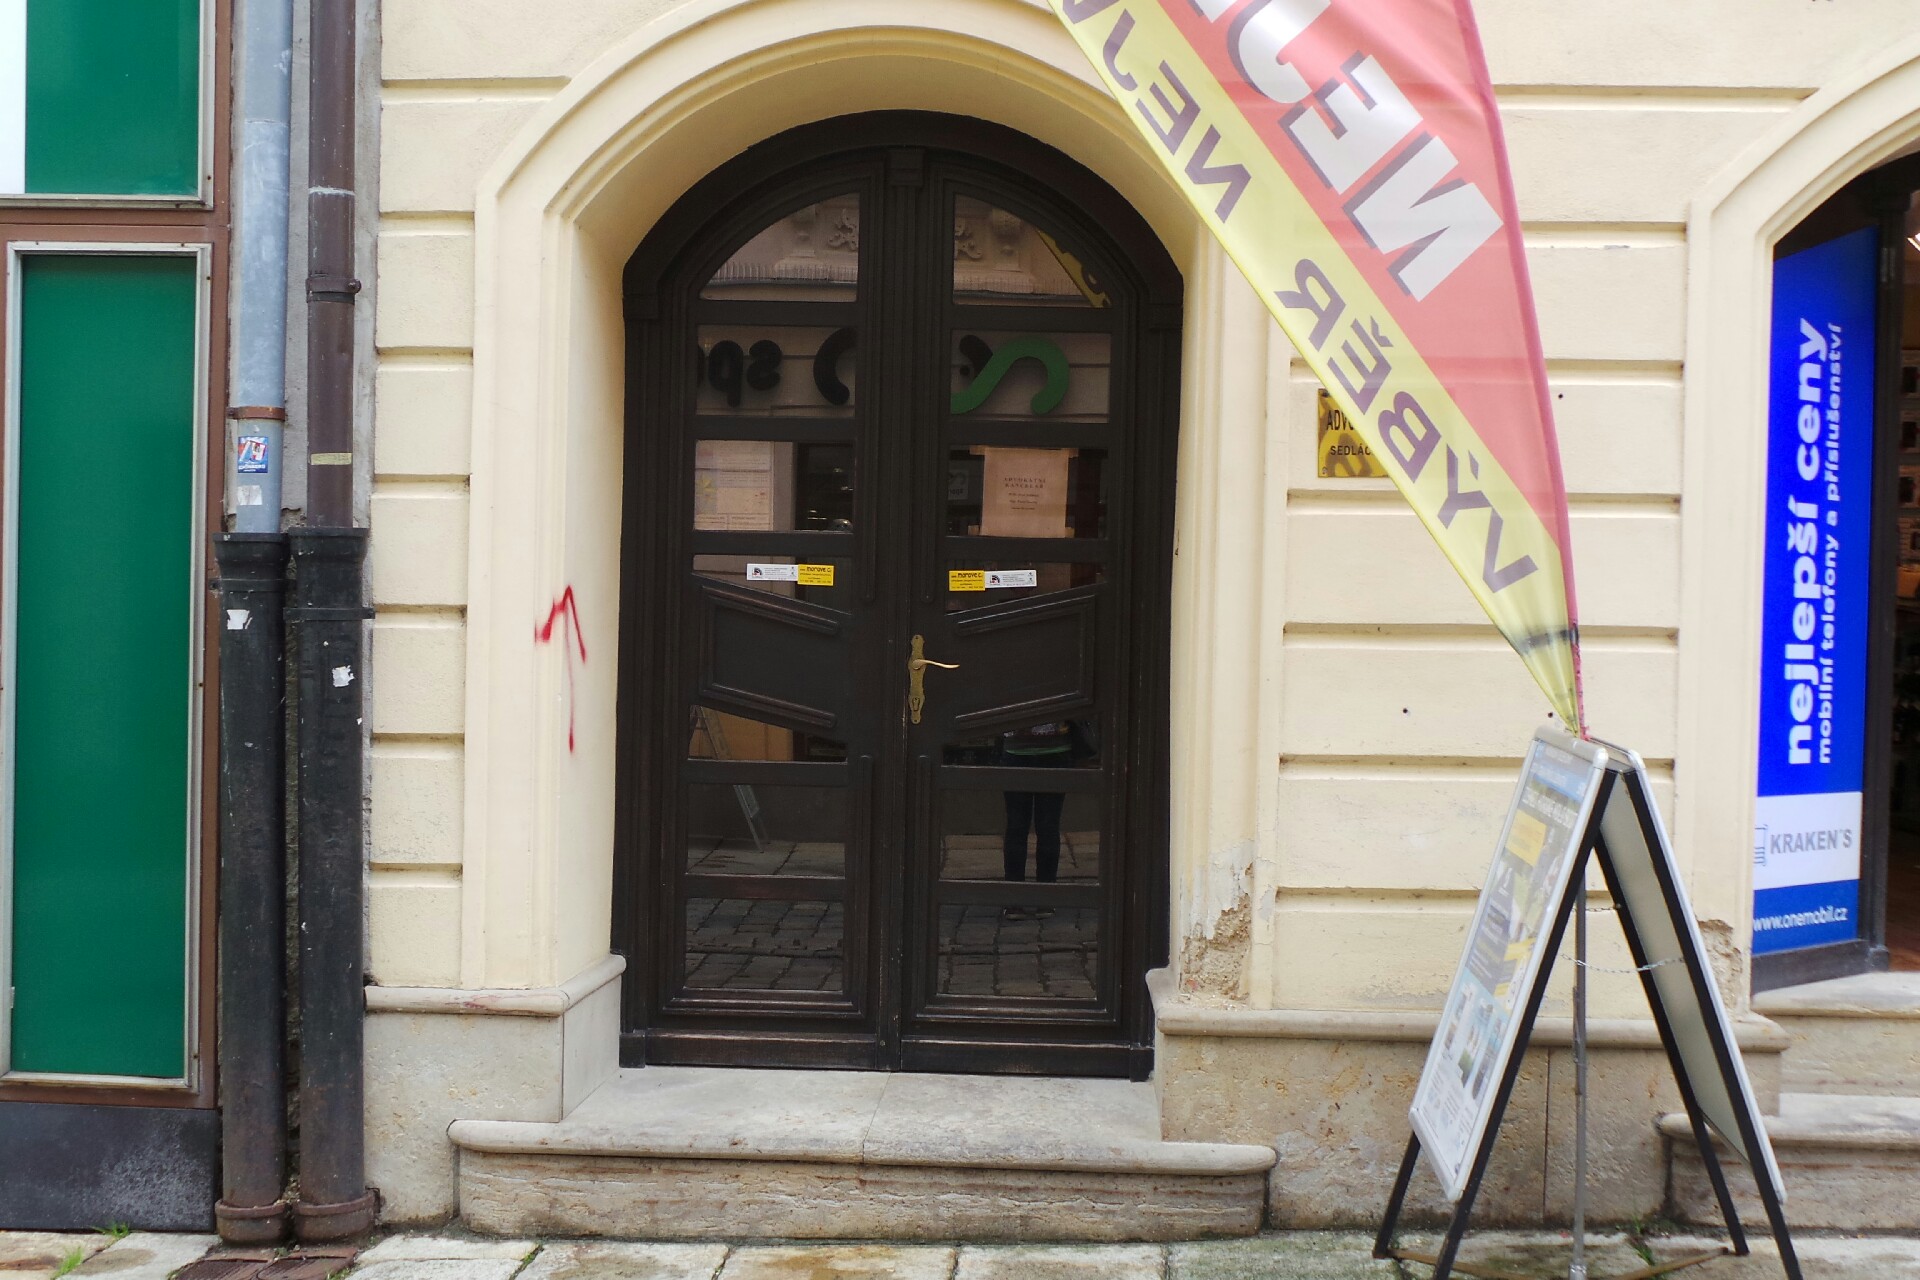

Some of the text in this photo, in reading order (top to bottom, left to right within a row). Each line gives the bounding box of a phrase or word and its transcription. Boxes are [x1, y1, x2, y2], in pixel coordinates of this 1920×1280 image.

[1784, 317, 1828, 764] nejlepší ceny
[1818, 322, 1842, 764] mobilní telefony a příslušenství
[1753, 904, 1849, 932] www.onemobil.cz
